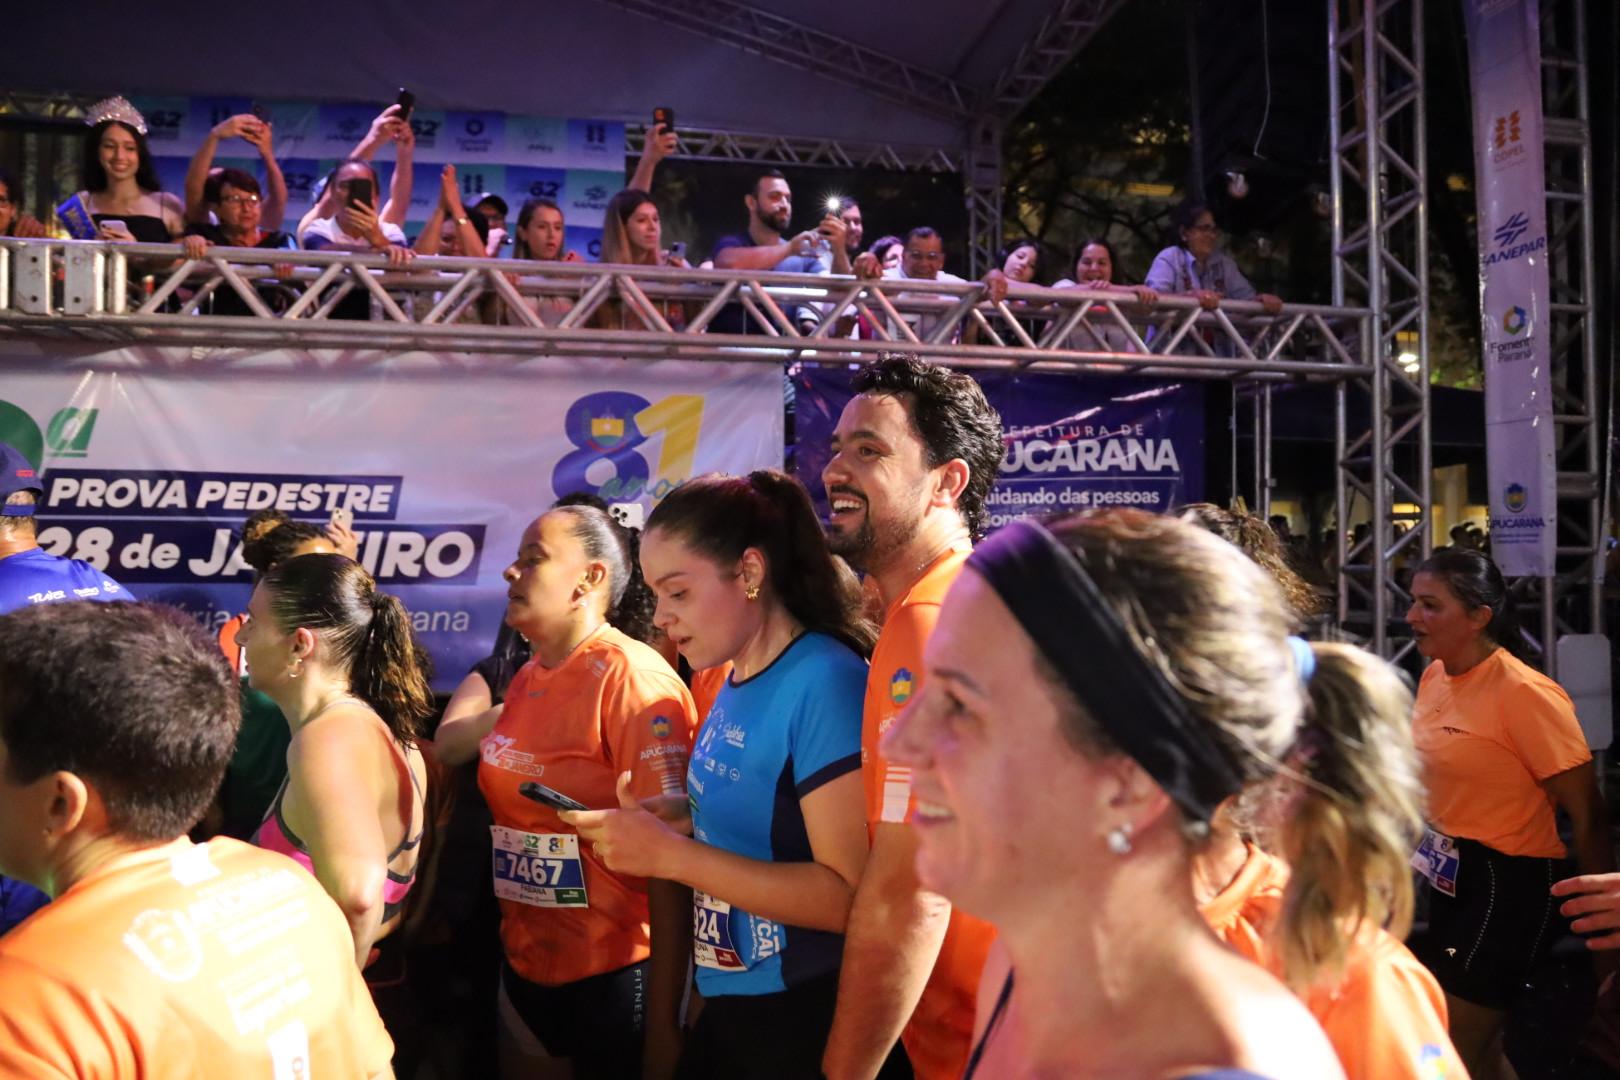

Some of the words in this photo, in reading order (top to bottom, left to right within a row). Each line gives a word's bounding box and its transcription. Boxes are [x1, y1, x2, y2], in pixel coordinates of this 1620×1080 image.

[1485, 236, 1545, 265] ANEPAR
[552, 391, 704, 503] 81
[999, 424, 1110, 438] REFEITURA
[1121, 424, 1144, 436] DE
[999, 438, 1180, 473] UCARANA
[49, 478, 189, 508] PROVA
[196, 480, 394, 512] PEDESTRE
[985, 486, 1057, 504] uidando
[1059, 487, 1090, 504] das
[1093, 490, 1160, 507] pessoas
[37, 526, 114, 572] 28
[120, 533, 181, 569] de
[188, 529, 475, 578] JAIRO
[506, 853, 563, 885] 7467
